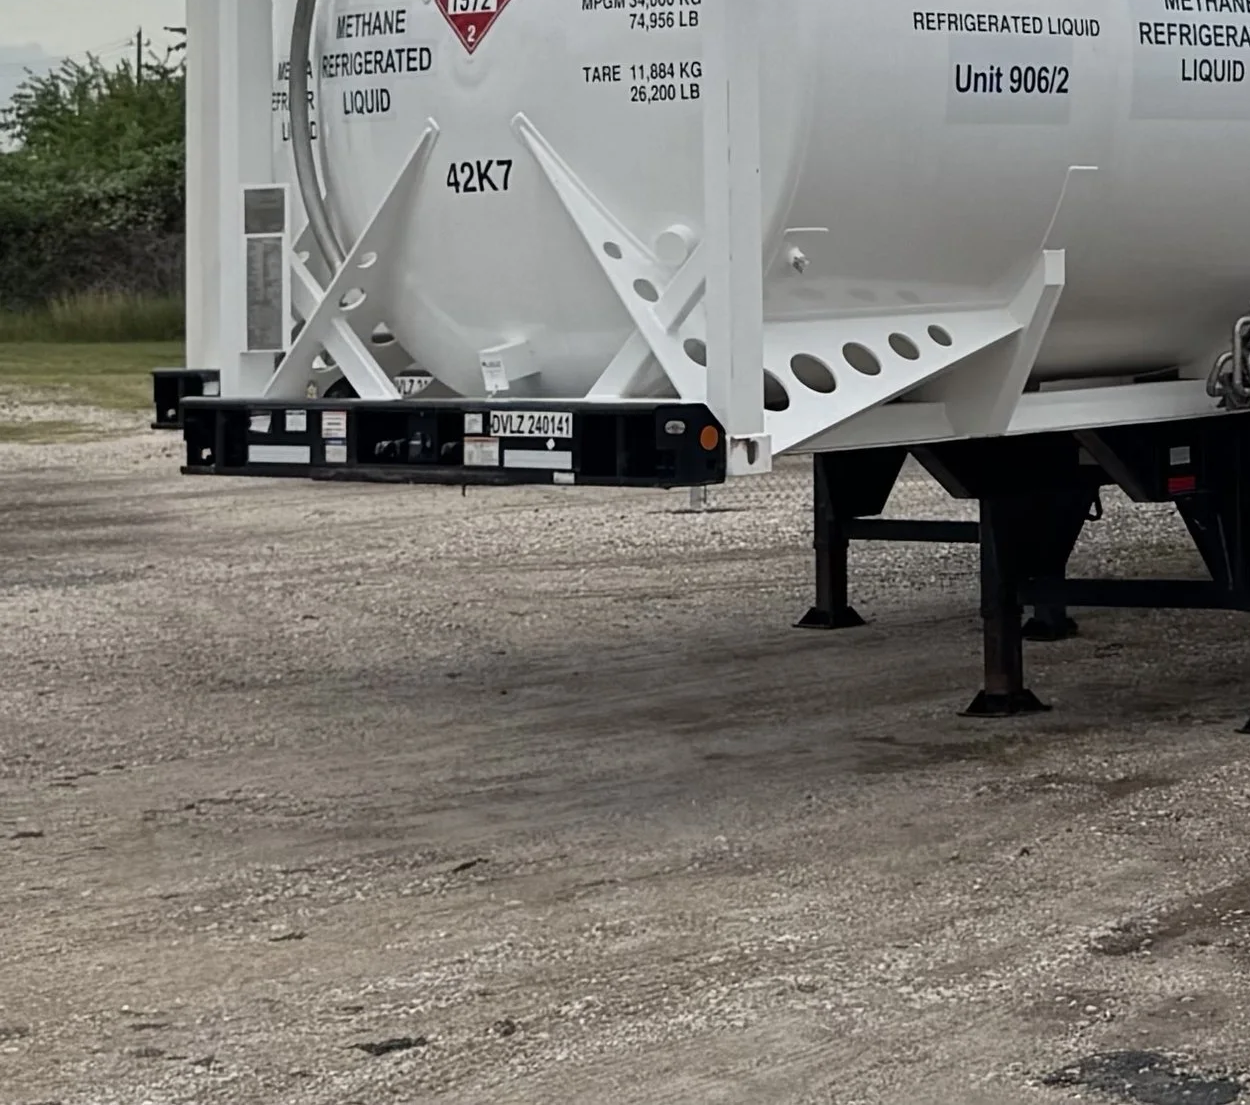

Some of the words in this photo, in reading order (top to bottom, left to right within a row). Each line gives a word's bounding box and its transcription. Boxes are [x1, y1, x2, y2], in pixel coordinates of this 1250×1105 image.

[336, 9, 406, 39] METHANE
[629, 11, 675, 32] 74,956
[679, 10, 699, 27] LB
[913, 11, 1043, 34] REFRIGERATED
[1048, 17, 1100, 37] LIQUID
[467, 24, 476, 43] 2
[322, 47, 432, 79] REFRIGERATED
[582, 65, 621, 82] TARE
[630, 62, 675, 83] 11,884
[679, 61, 703, 79] KG
[1181, 59, 1245, 82] LIQUID
[955, 64, 1003, 93] Unit
[1008, 65, 1070, 94] 906/2
[343, 88, 390, 114] LIQUID
[630, 84, 676, 105] 26,200
[680, 83, 700, 100] LB
[446, 159, 513, 193] 42K7
[491, 414, 525, 434] DVLZ
[528, 415, 571, 434] 240141
